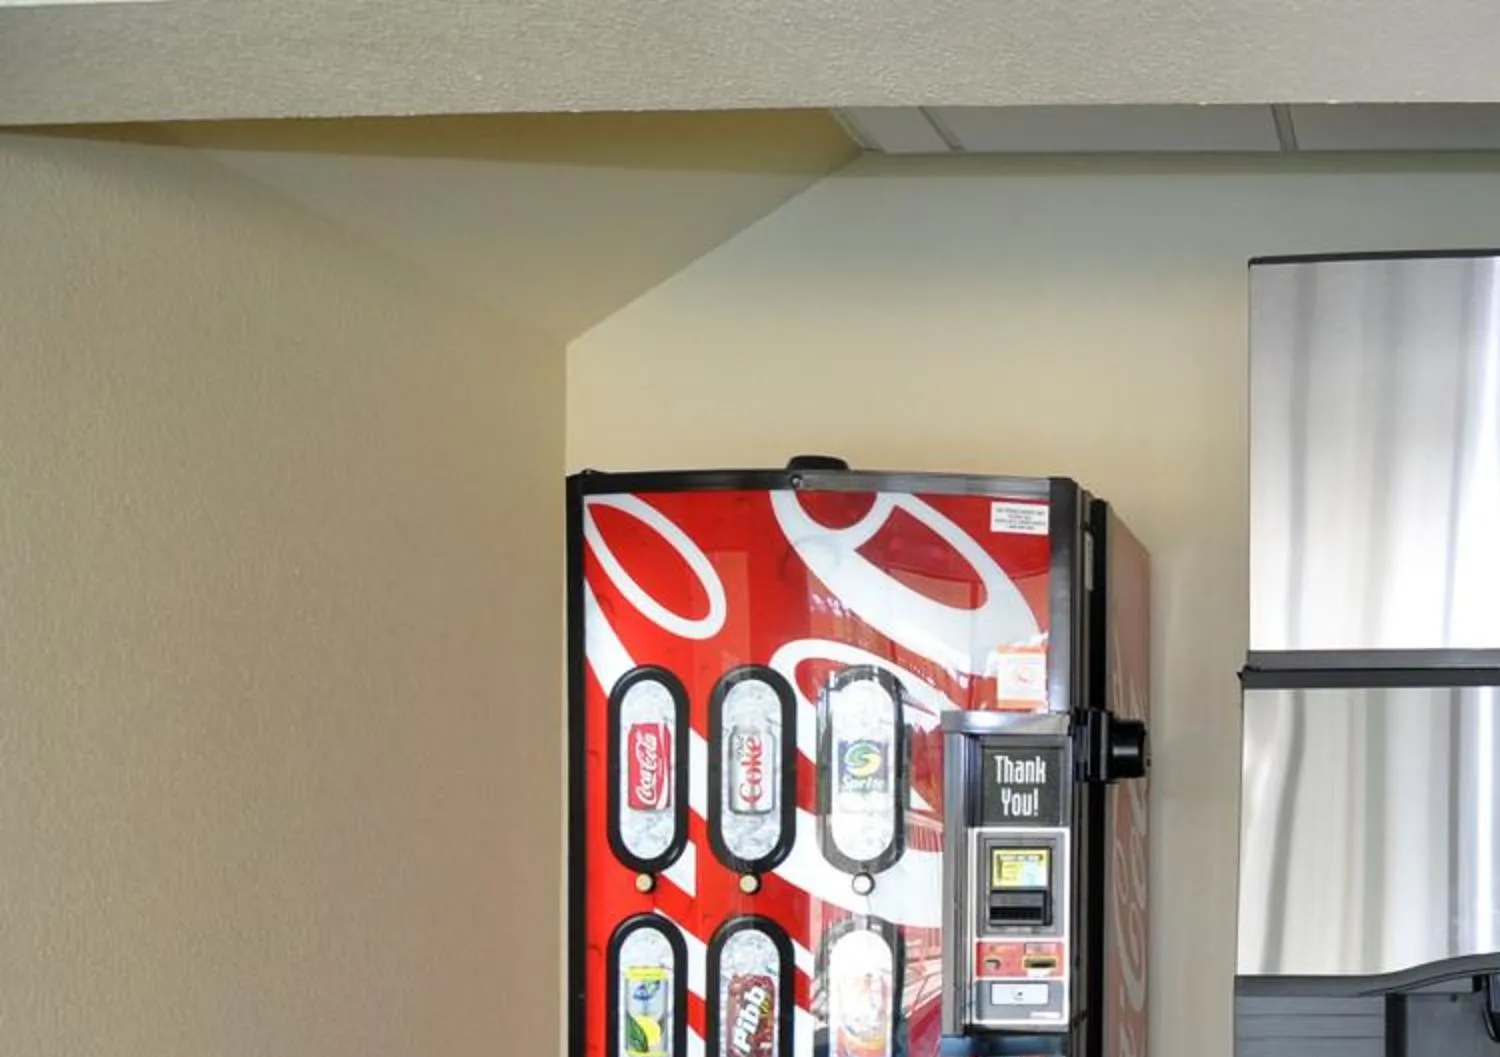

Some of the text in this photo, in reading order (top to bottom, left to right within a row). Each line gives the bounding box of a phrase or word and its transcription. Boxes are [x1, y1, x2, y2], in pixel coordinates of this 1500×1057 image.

[634, 731, 657, 806] Coca-Cola
[739, 734, 763, 803] Coke
[994, 755, 1046, 784] Thank
[1001, 787, 1038, 816] You!
[733, 985, 769, 1055] Pibb
